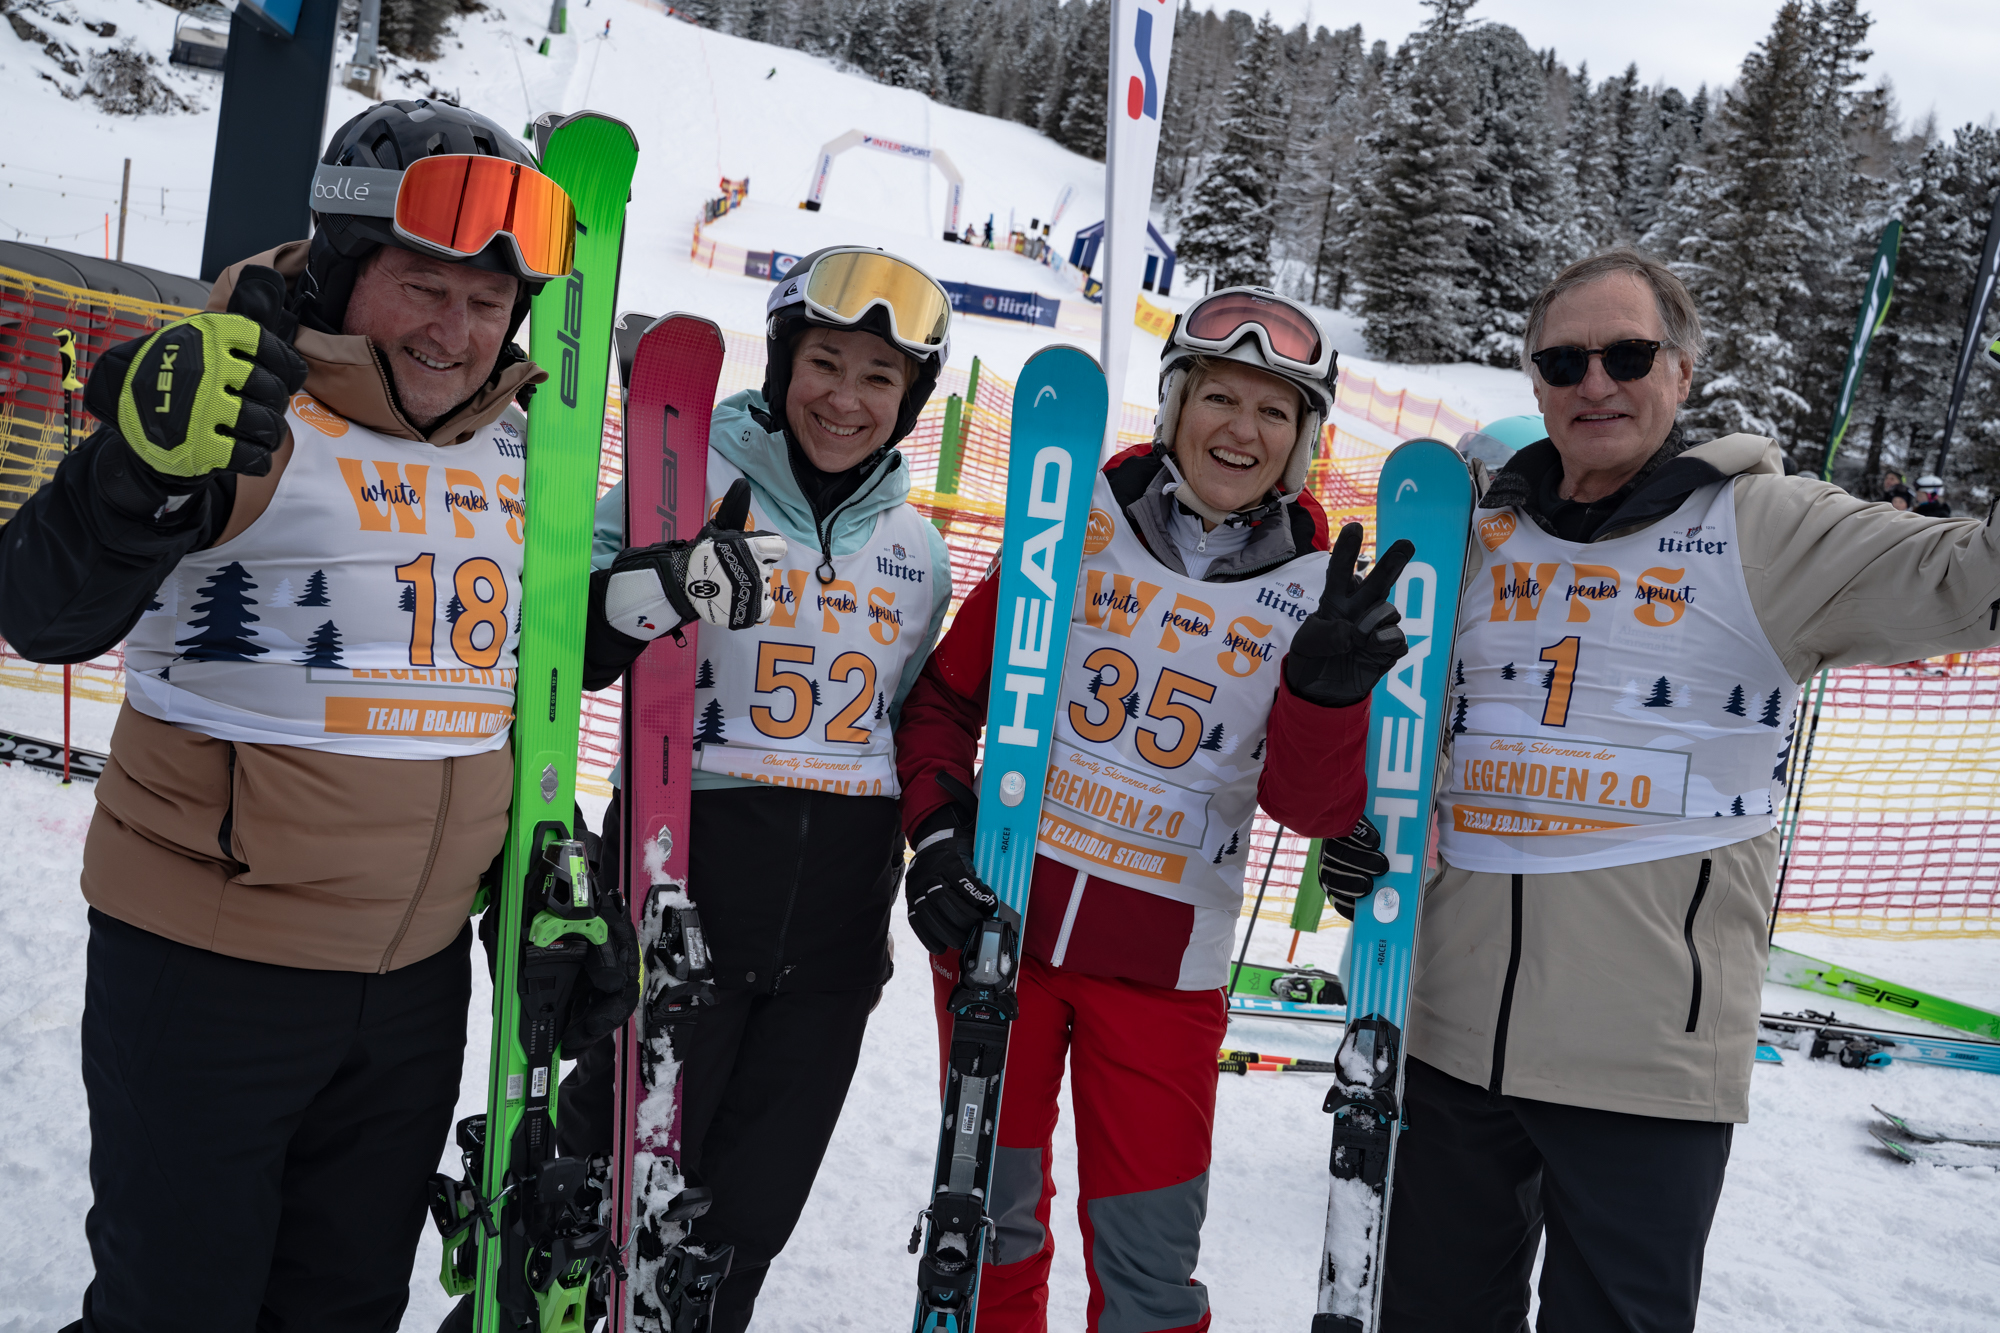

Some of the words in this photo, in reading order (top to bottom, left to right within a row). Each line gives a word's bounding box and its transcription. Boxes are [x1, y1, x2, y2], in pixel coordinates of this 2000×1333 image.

[872, 138, 932, 158] INTERSPORT
[314, 175, 370, 201] bollé
[996, 295, 1045, 319] Hirter
[155, 344, 180, 413] LEKI
[492, 437, 527, 460] Hirt
[361, 479, 421, 506] white
[445, 490, 490, 513] peaks
[1657, 537, 1728, 556] Hirter
[717, 542, 753, 625] ROSSIGNOL
[875, 555, 926, 584] Hirter
[771, 584, 797, 604] ite
[816, 593, 858, 614] peaks
[868, 604, 904, 627] spirit
[997, 446, 1073, 748] HEAD
[1256, 587, 1312, 622] Hirte
[1500, 578, 1542, 601] white
[1565, 581, 1621, 602] peaks
[1635, 585, 1697, 604] spirit
[394, 552, 509, 670] 18
[1092, 588, 1142, 615] white
[1160, 610, 1213, 637] peaks
[1221, 631, 1278, 663] spirit
[749, 640, 878, 745] 52
[1539, 635, 1582, 728] 1
[366, 706, 419, 731] TEAM
[422, 708, 477, 733] BOJAN
[478, 709, 512, 735] KRIŽ
[1067, 646, 1218, 770] 35
[1373, 561, 1438, 874] HEAD
[762, 754, 801, 770] Charity
[803, 757, 850, 771] Skirennen
[850, 760, 863, 771] der
[1489, 739, 1527, 756] Charity
[1528, 742, 1592, 760] Skirennen
[1593, 748, 1616, 761] der
[1009, 775, 1017, 791] EMC
[1069, 752, 1100, 777] Charity
[1101, 766, 1149, 791] Skirennen
[1149, 782, 1167, 796] der
[1463, 759, 1590, 802] LEGENDEN
[1598, 771, 1652, 809] 2.0
[1045, 764, 1144, 830] EGENDEN
[1143, 804, 1186, 839] 2.0
[1463, 809, 1494, 829] TEAM
[1494, 813, 1543, 833] FRANZ
[1051, 823, 1110, 861] CLAUDIA
[1113, 851, 1167, 875] STROBL
[958, 877, 996, 907] reusch
